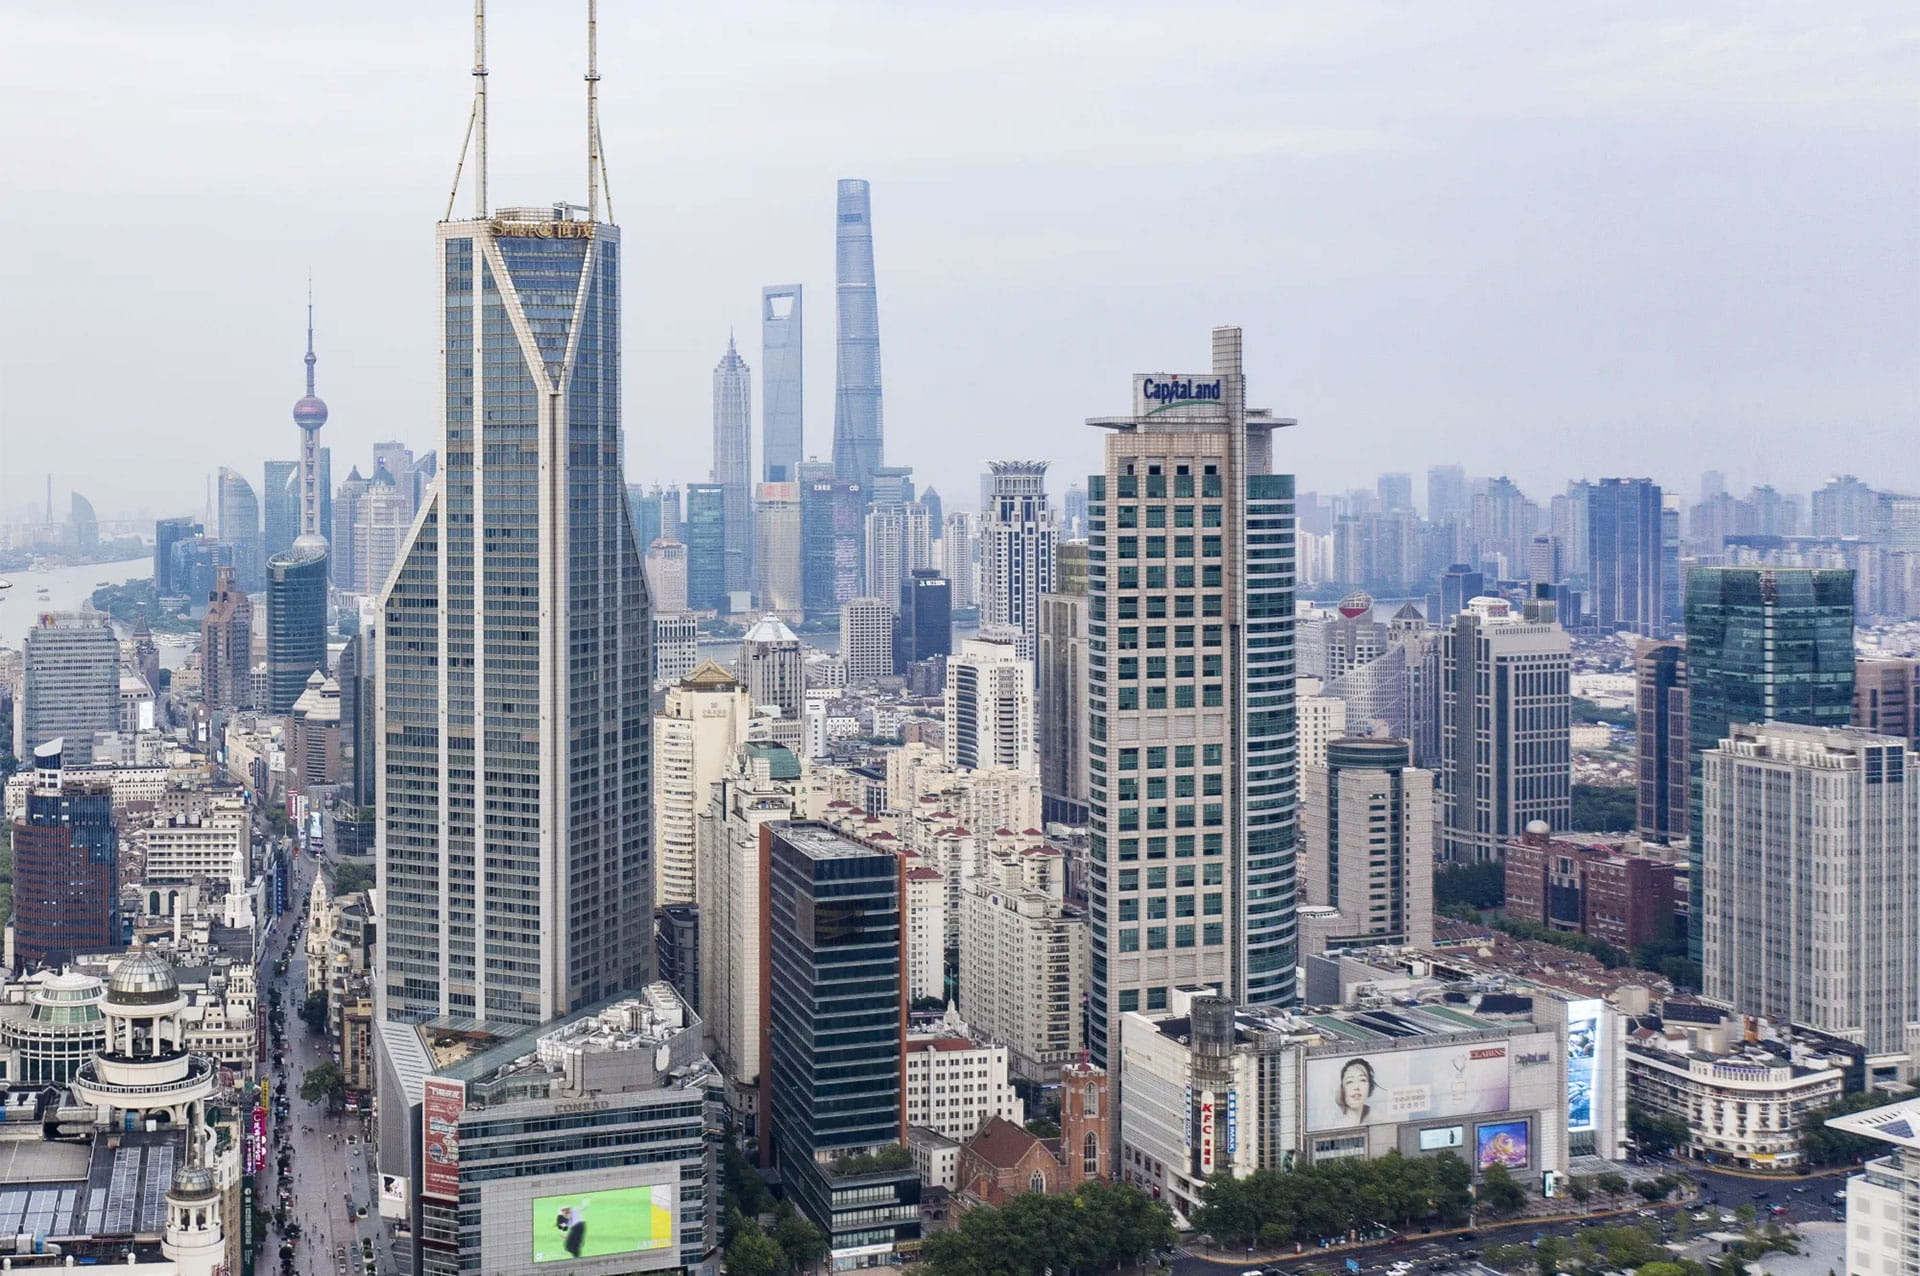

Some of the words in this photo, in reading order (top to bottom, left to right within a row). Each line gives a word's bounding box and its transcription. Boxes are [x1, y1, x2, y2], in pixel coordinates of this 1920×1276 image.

[1143, 375, 1221, 404] CapitaLand
[1470, 1048, 1505, 1059] CLARINS
[555, 1101, 609, 1113] CONRAD
[1202, 1104, 1213, 1135] KFC
